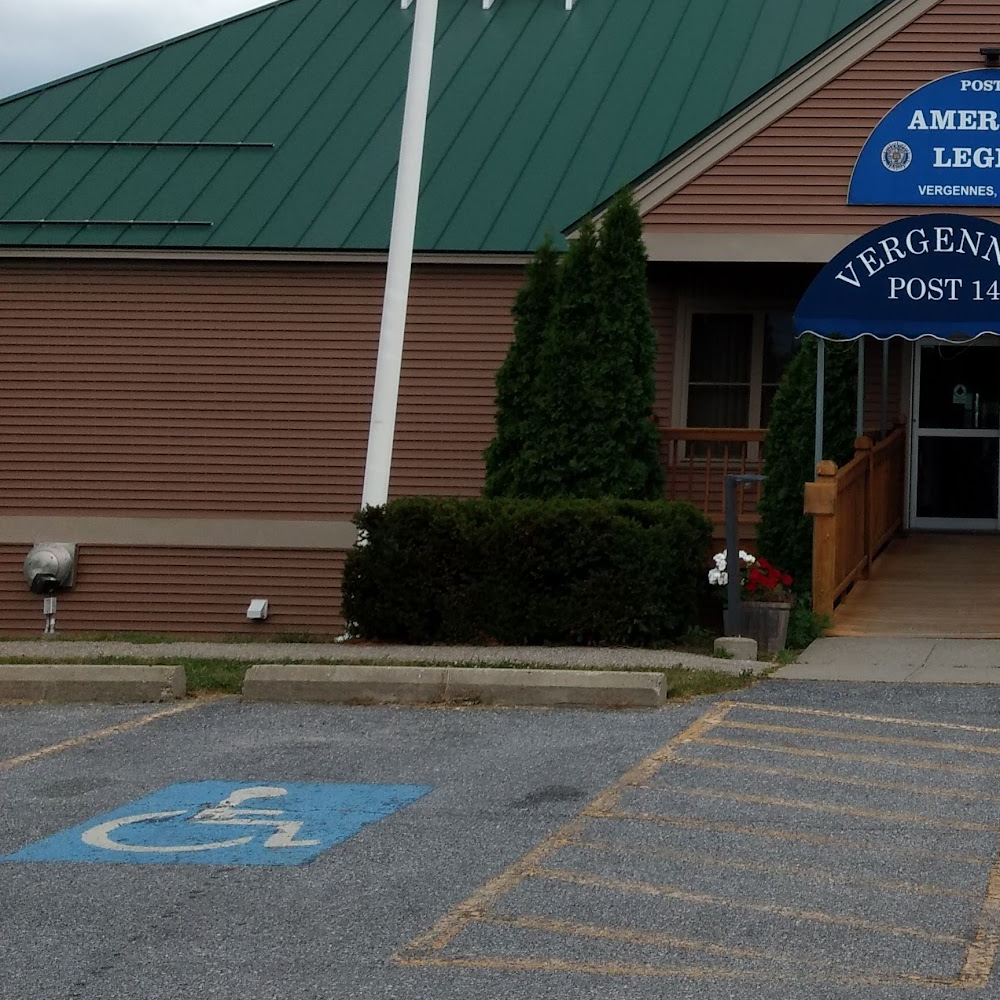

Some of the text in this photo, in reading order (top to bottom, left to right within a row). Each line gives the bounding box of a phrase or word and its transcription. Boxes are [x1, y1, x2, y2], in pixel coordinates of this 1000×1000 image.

[918, 185, 998, 198] VERGENNES,
[888, 277, 1000, 301] POST 14
